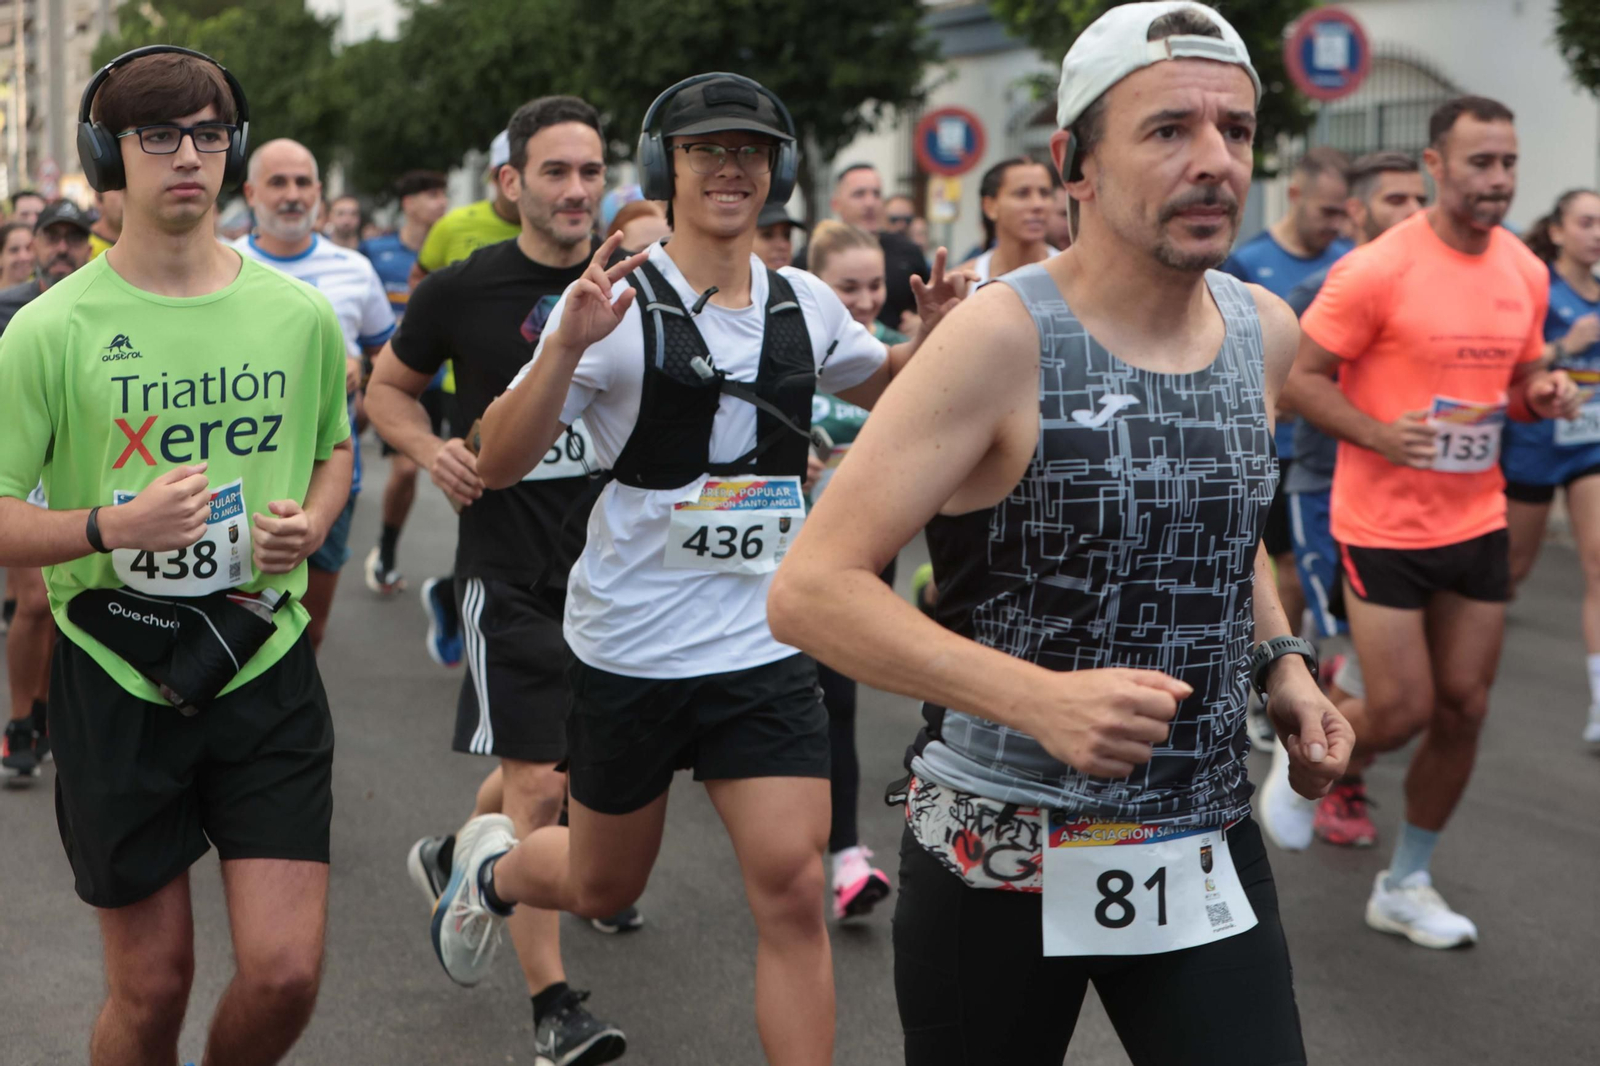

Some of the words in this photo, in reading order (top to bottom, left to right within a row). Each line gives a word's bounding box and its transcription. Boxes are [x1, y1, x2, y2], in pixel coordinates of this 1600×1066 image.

[111, 363, 286, 414] Triatlón
[112, 414, 283, 469] Xerez
[208, 491, 237, 510] PULAR
[739, 486, 791, 498] POPULAR
[739, 499, 768, 508] SANTO
[769, 498, 798, 507] ANGEL
[220, 503, 241, 518] ANGEL
[682, 524, 764, 560] 436
[130, 540, 218, 580] 438
[107, 601, 181, 629] Quechua
[1094, 866, 1167, 929] 81
